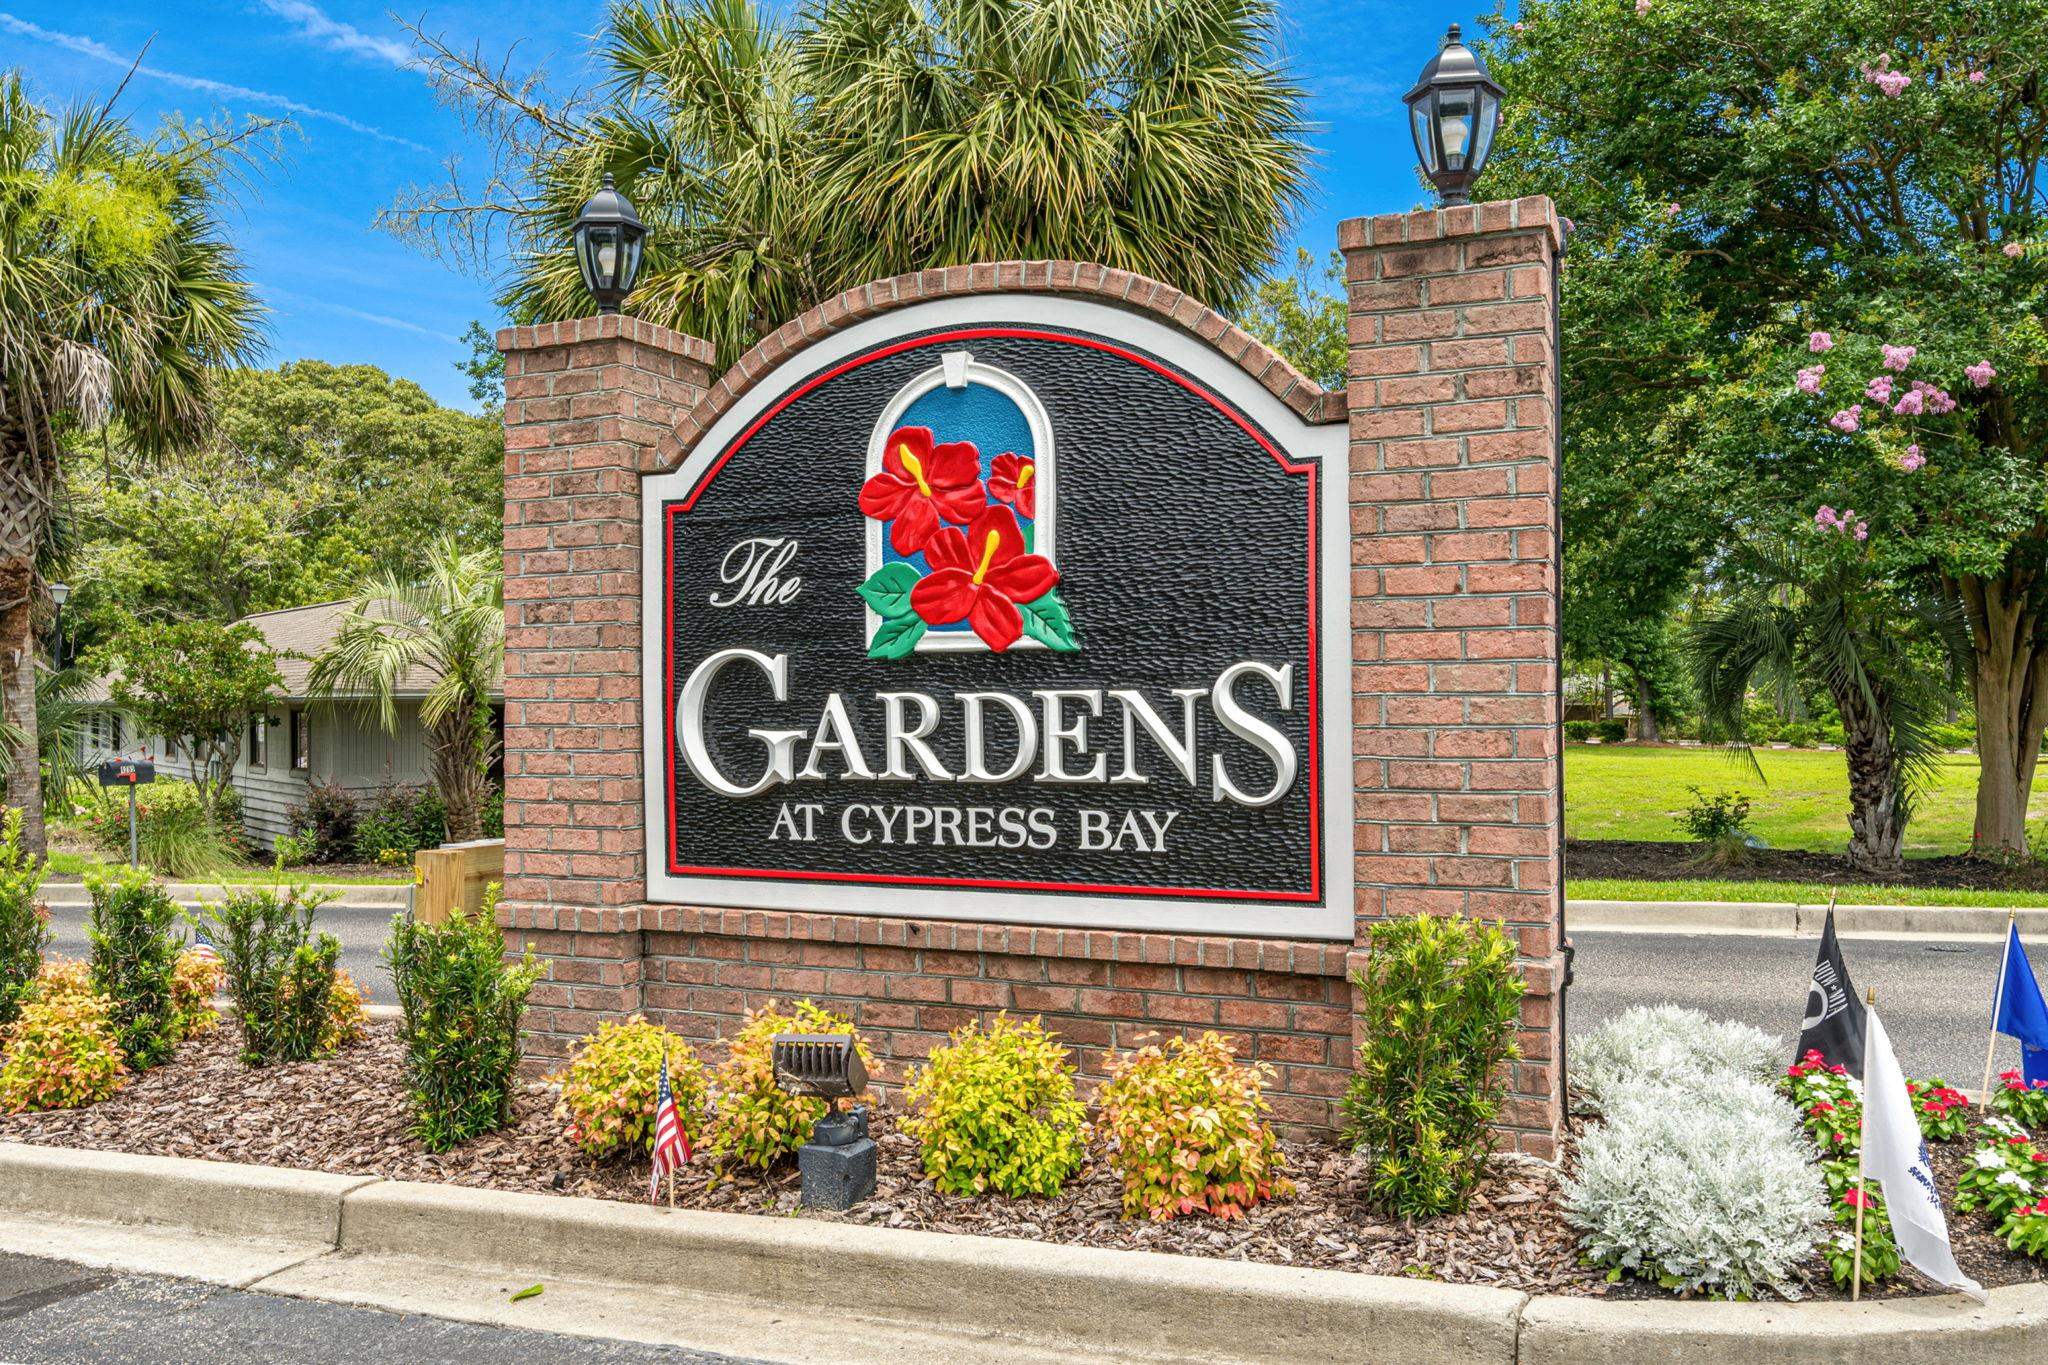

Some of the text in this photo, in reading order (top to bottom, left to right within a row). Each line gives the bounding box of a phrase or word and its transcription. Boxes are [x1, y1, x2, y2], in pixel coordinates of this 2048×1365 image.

[709, 536, 803, 607] The
[676, 648, 1298, 806] GARDENS
[768, 802, 1181, 853] AT CYPRESS BAY
